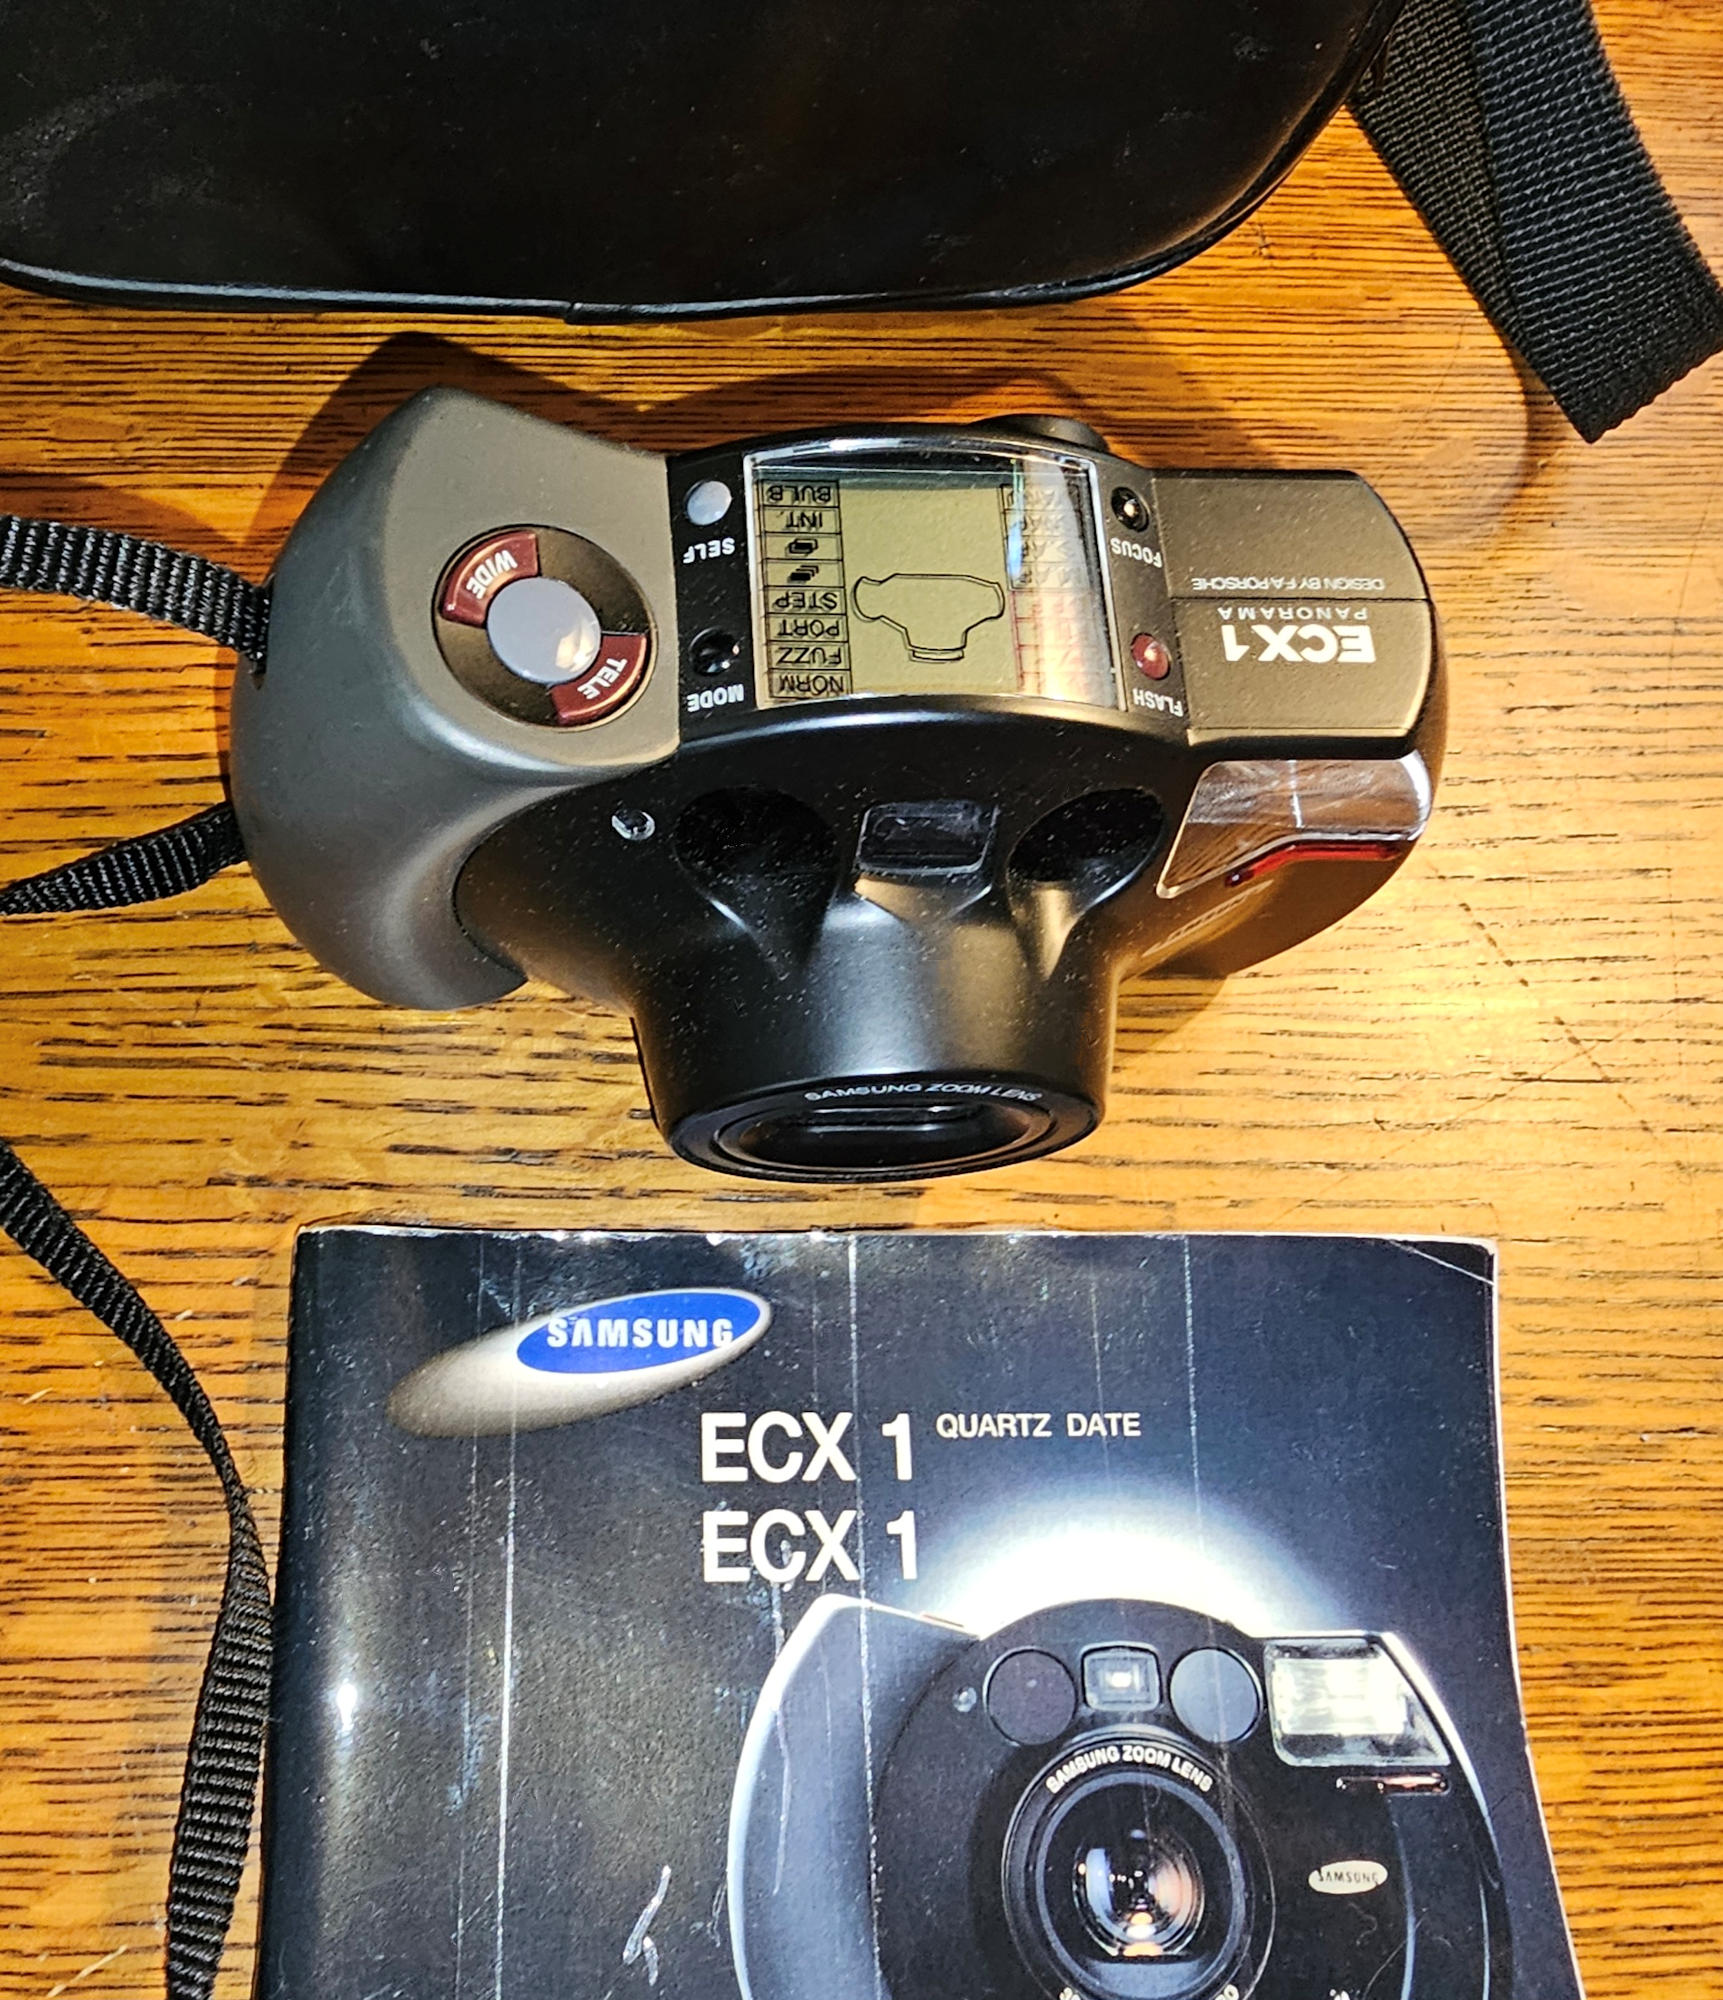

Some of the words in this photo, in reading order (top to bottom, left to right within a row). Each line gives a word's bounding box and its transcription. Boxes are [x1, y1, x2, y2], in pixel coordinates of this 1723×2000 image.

[767, 484, 831, 501] BULB
[682, 537, 735, 564] SELF
[1110, 537, 1163, 568] FOCUS
[465, 549, 518, 600] WIDE
[1299, 577, 1321, 591] BY
[1322, 577, 1385, 591] DESIGN
[771, 592, 838, 609] STEP
[1217, 607, 1368, 620] PANORAMA
[778, 619, 840, 637] PORT
[776, 647, 842, 665] FUZZ
[577, 657, 627, 699] TELE
[779, 674, 844, 692] NORM
[687, 684, 744, 712] MODE
[1133, 688, 1183, 717] FLASH
[804, 1083, 921, 1100] SAMSUNG
[925, 1083, 990, 1095] ZOOM
[988, 1087, 1042, 1101] LENS
[547, 1318, 734, 1347] SAMSUNG
[701, 1412, 857, 1483] ECX
[881, 1413, 913, 1481] 1
[936, 1413, 1052, 1440] QUARTZ
[1067, 1413, 1141, 1438] DATE
[702, 1510, 861, 1583] ECX
[886, 1510, 918, 1580] 1
[1045, 1746, 1120, 1794] SAMSUNG
[1121, 1745, 1172, 1769] ZOOM
[1171, 1758, 1214, 1793] LENS
[1318, 1869, 1380, 1886] SAMSUNG
